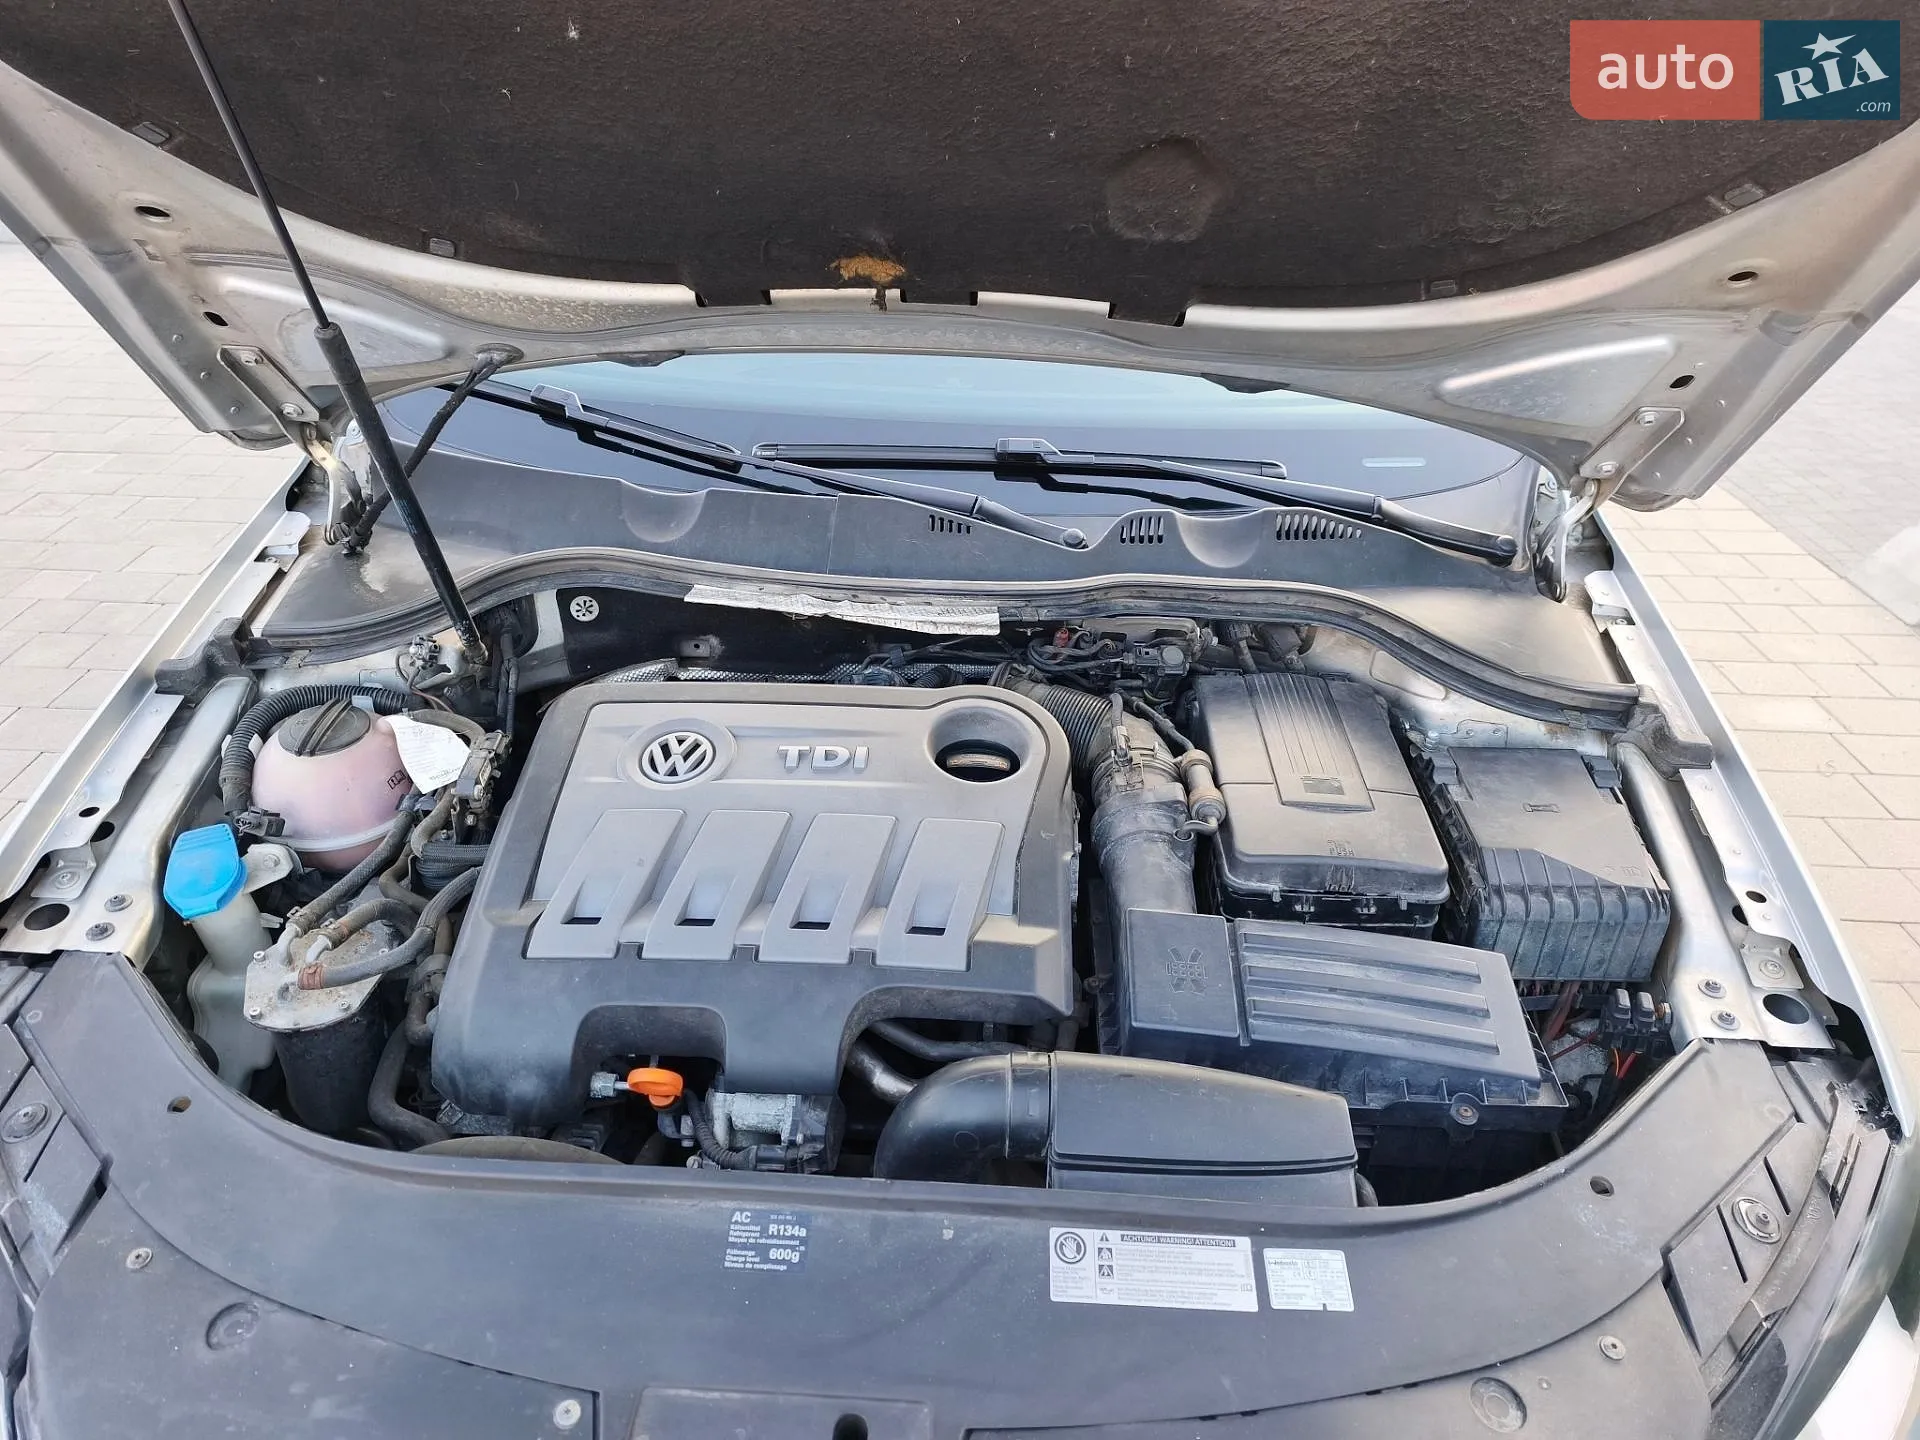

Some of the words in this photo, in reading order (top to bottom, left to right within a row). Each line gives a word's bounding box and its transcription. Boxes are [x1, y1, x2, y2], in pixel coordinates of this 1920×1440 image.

[778, 745, 869, 771] TDI
[731, 1211, 751, 1223] AC
[769, 1224, 807, 1237] R134a
[1123, 1234, 1158, 1244] ACHTUNG!
[1159, 1236, 1194, 1246] WARNING!
[1195, 1237, 1234, 1247] ATTENTION!
[769, 1248, 800, 1263] 600g
